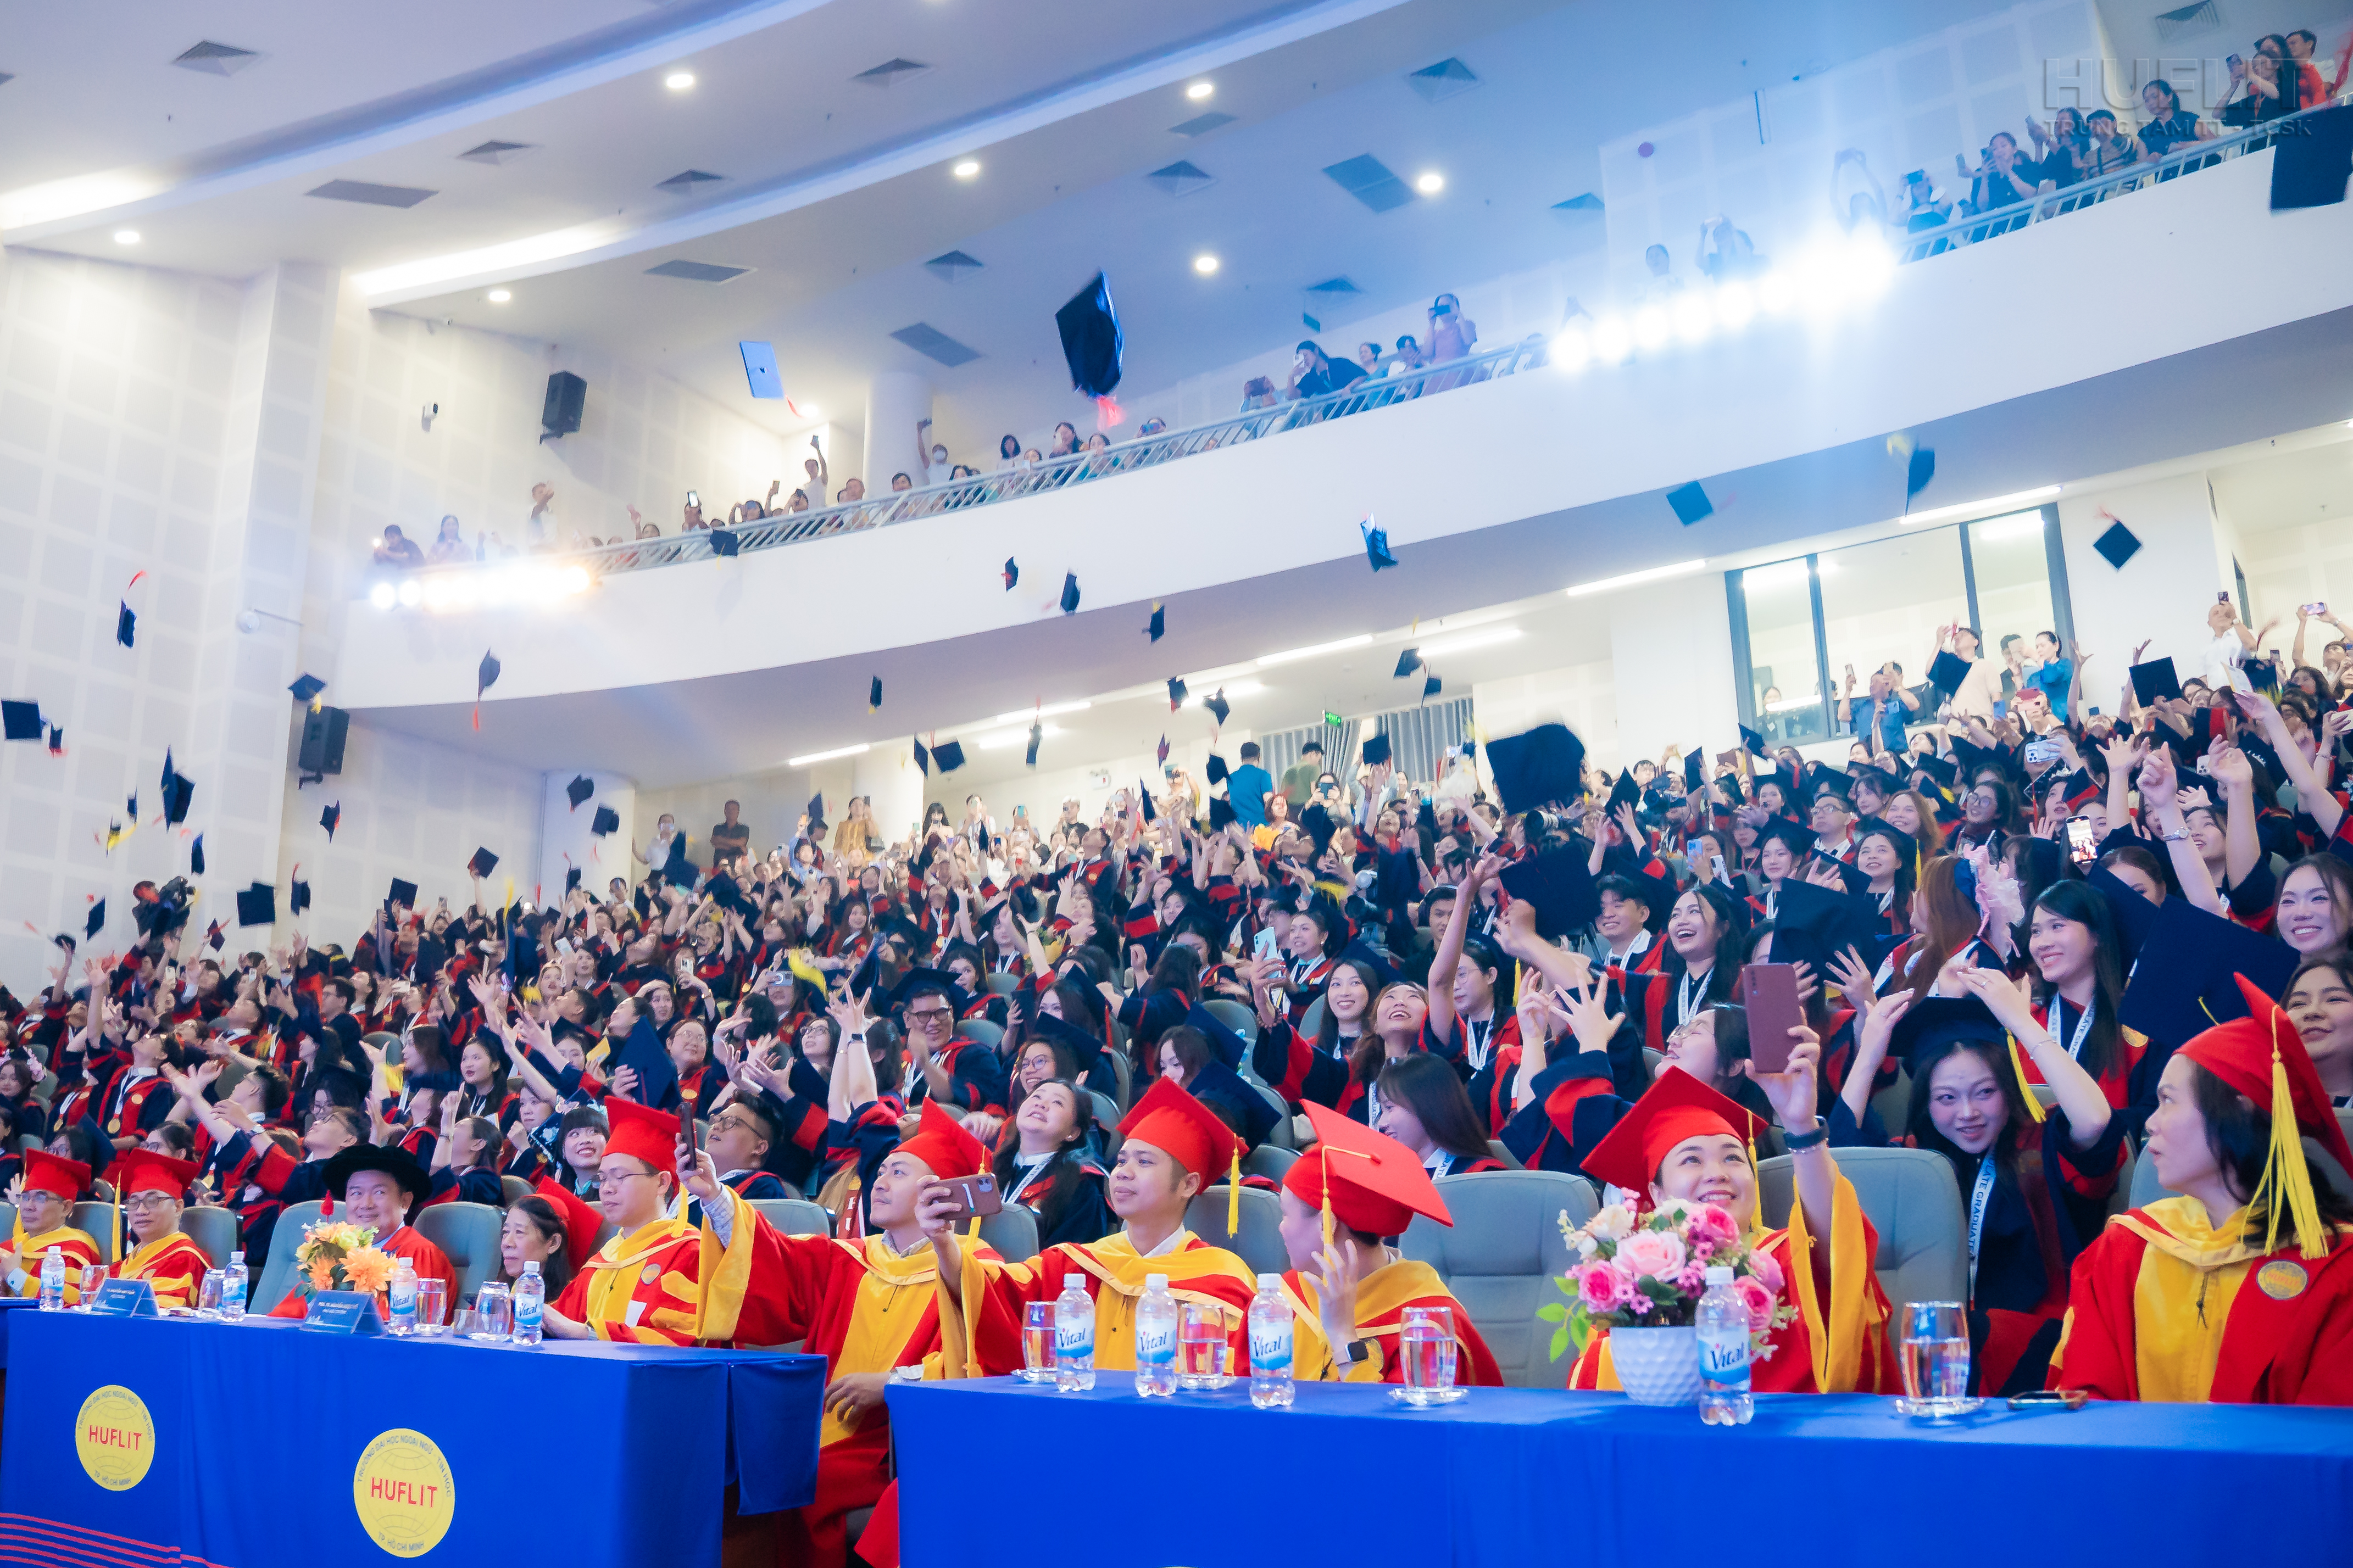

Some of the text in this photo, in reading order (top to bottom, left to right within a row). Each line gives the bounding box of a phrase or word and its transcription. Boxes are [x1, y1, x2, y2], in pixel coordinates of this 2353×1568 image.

[392, 1294, 409, 1307] Vital
[519, 1303, 538, 1317] Vital
[1059, 1327, 1086, 1348] Vital
[1139, 1331, 1167, 1352] Vital
[1254, 1335, 1282, 1357] Vital
[1710, 1342, 1744, 1370] Vital
[88, 1424, 142, 1451] HUFLIT
[371, 1476, 438, 1509] HUFLIT
